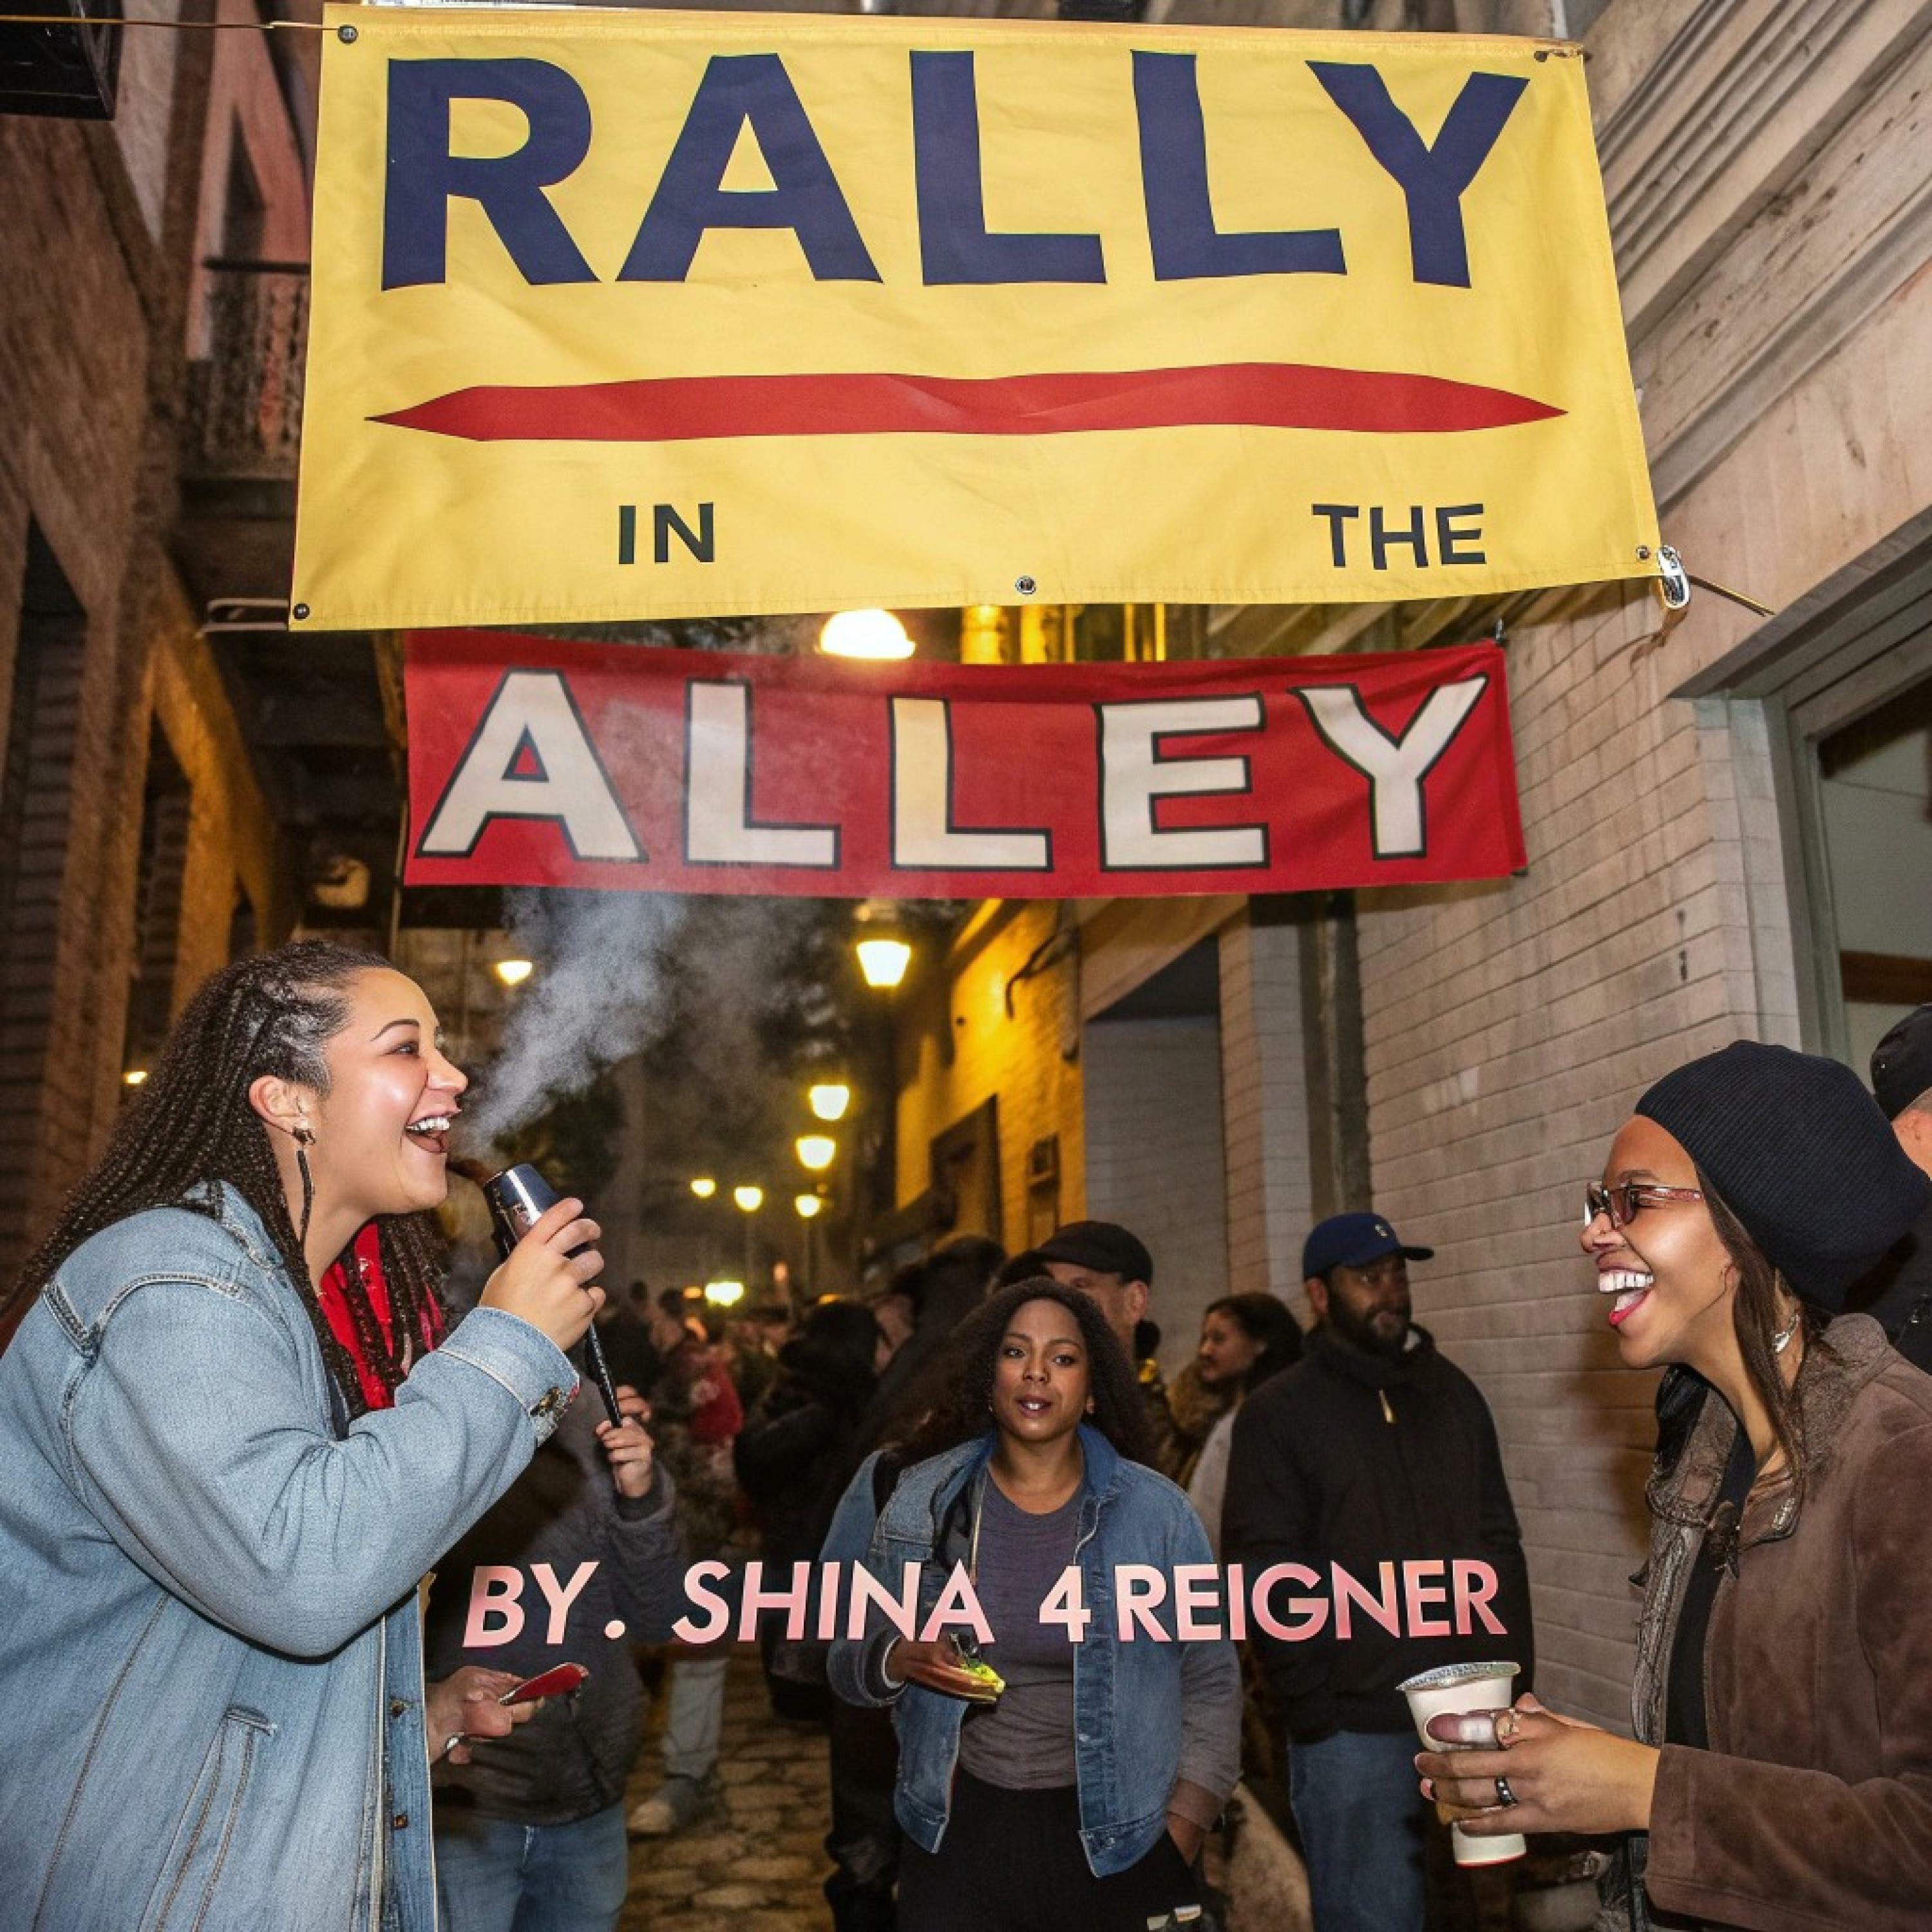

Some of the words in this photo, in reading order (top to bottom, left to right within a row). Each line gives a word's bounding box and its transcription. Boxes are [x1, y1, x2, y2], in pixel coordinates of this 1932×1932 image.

[383, 51, 1530, 292] RALLY
[618, 503, 715, 564] IN
[1312, 502, 1486, 569] THE
[419, 670, 1485, 871] ALLEY
